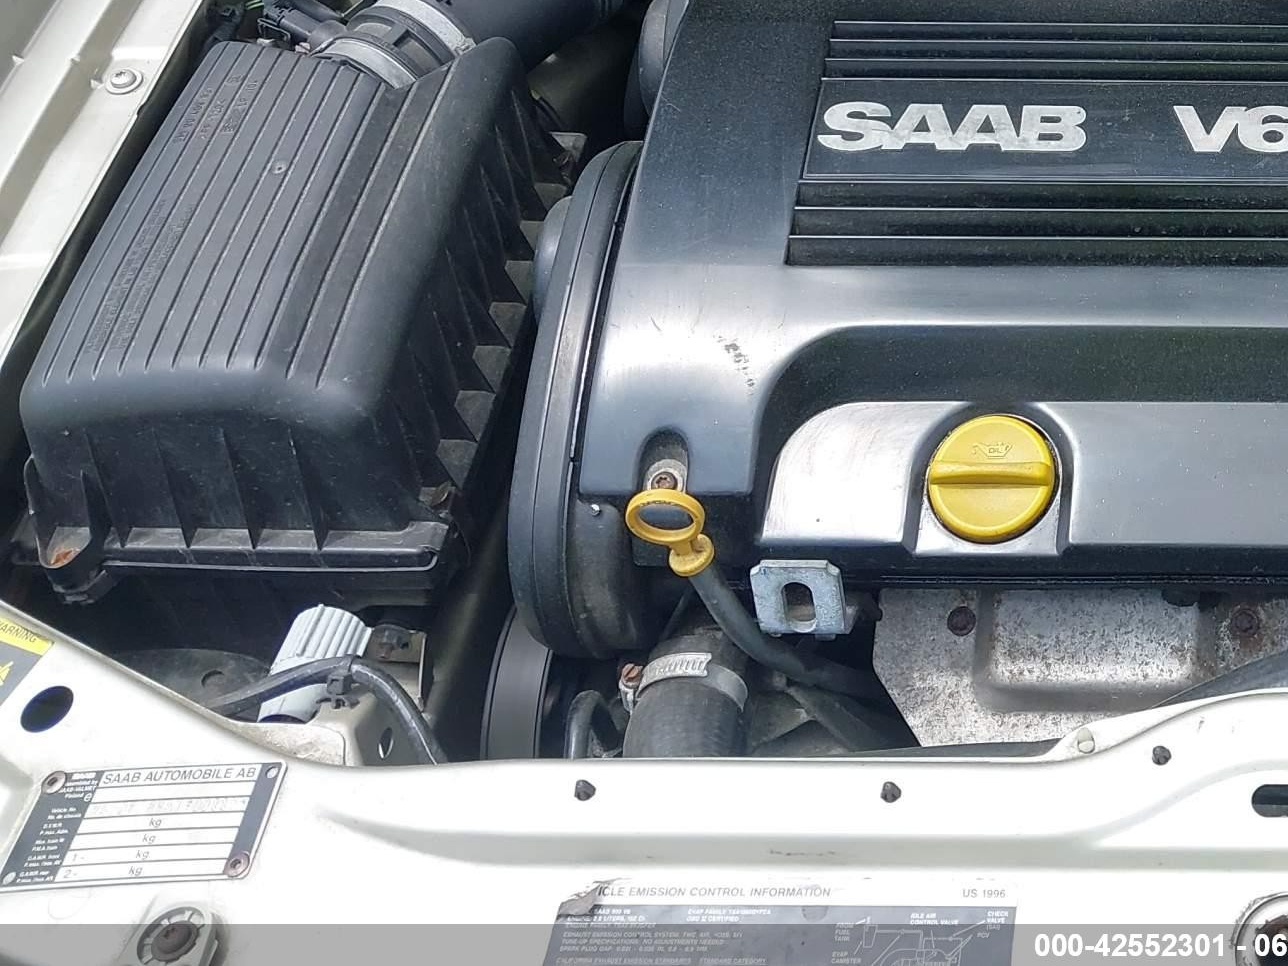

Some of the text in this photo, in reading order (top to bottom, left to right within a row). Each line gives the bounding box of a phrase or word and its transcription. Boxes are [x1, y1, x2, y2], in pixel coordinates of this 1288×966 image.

[817, 101, 1087, 152] SAAB
[0, 619, 37, 643] ARNING
[102, 772, 141, 785] SAAB
[143, 769, 232, 782] AUTOMOBILE
[235, 768, 257, 778] AB
[149, 818, 162, 828] kg
[142, 833, 156, 843] kg
[135, 849, 150, 860] kg
[128, 865, 142, 876] kg
[629, 887, 686, 897] EMISSION
[689, 887, 745, 897] CONTROL
[750, 887, 831, 897] INFORMATION
[962, 889, 1006, 898] US 1996
